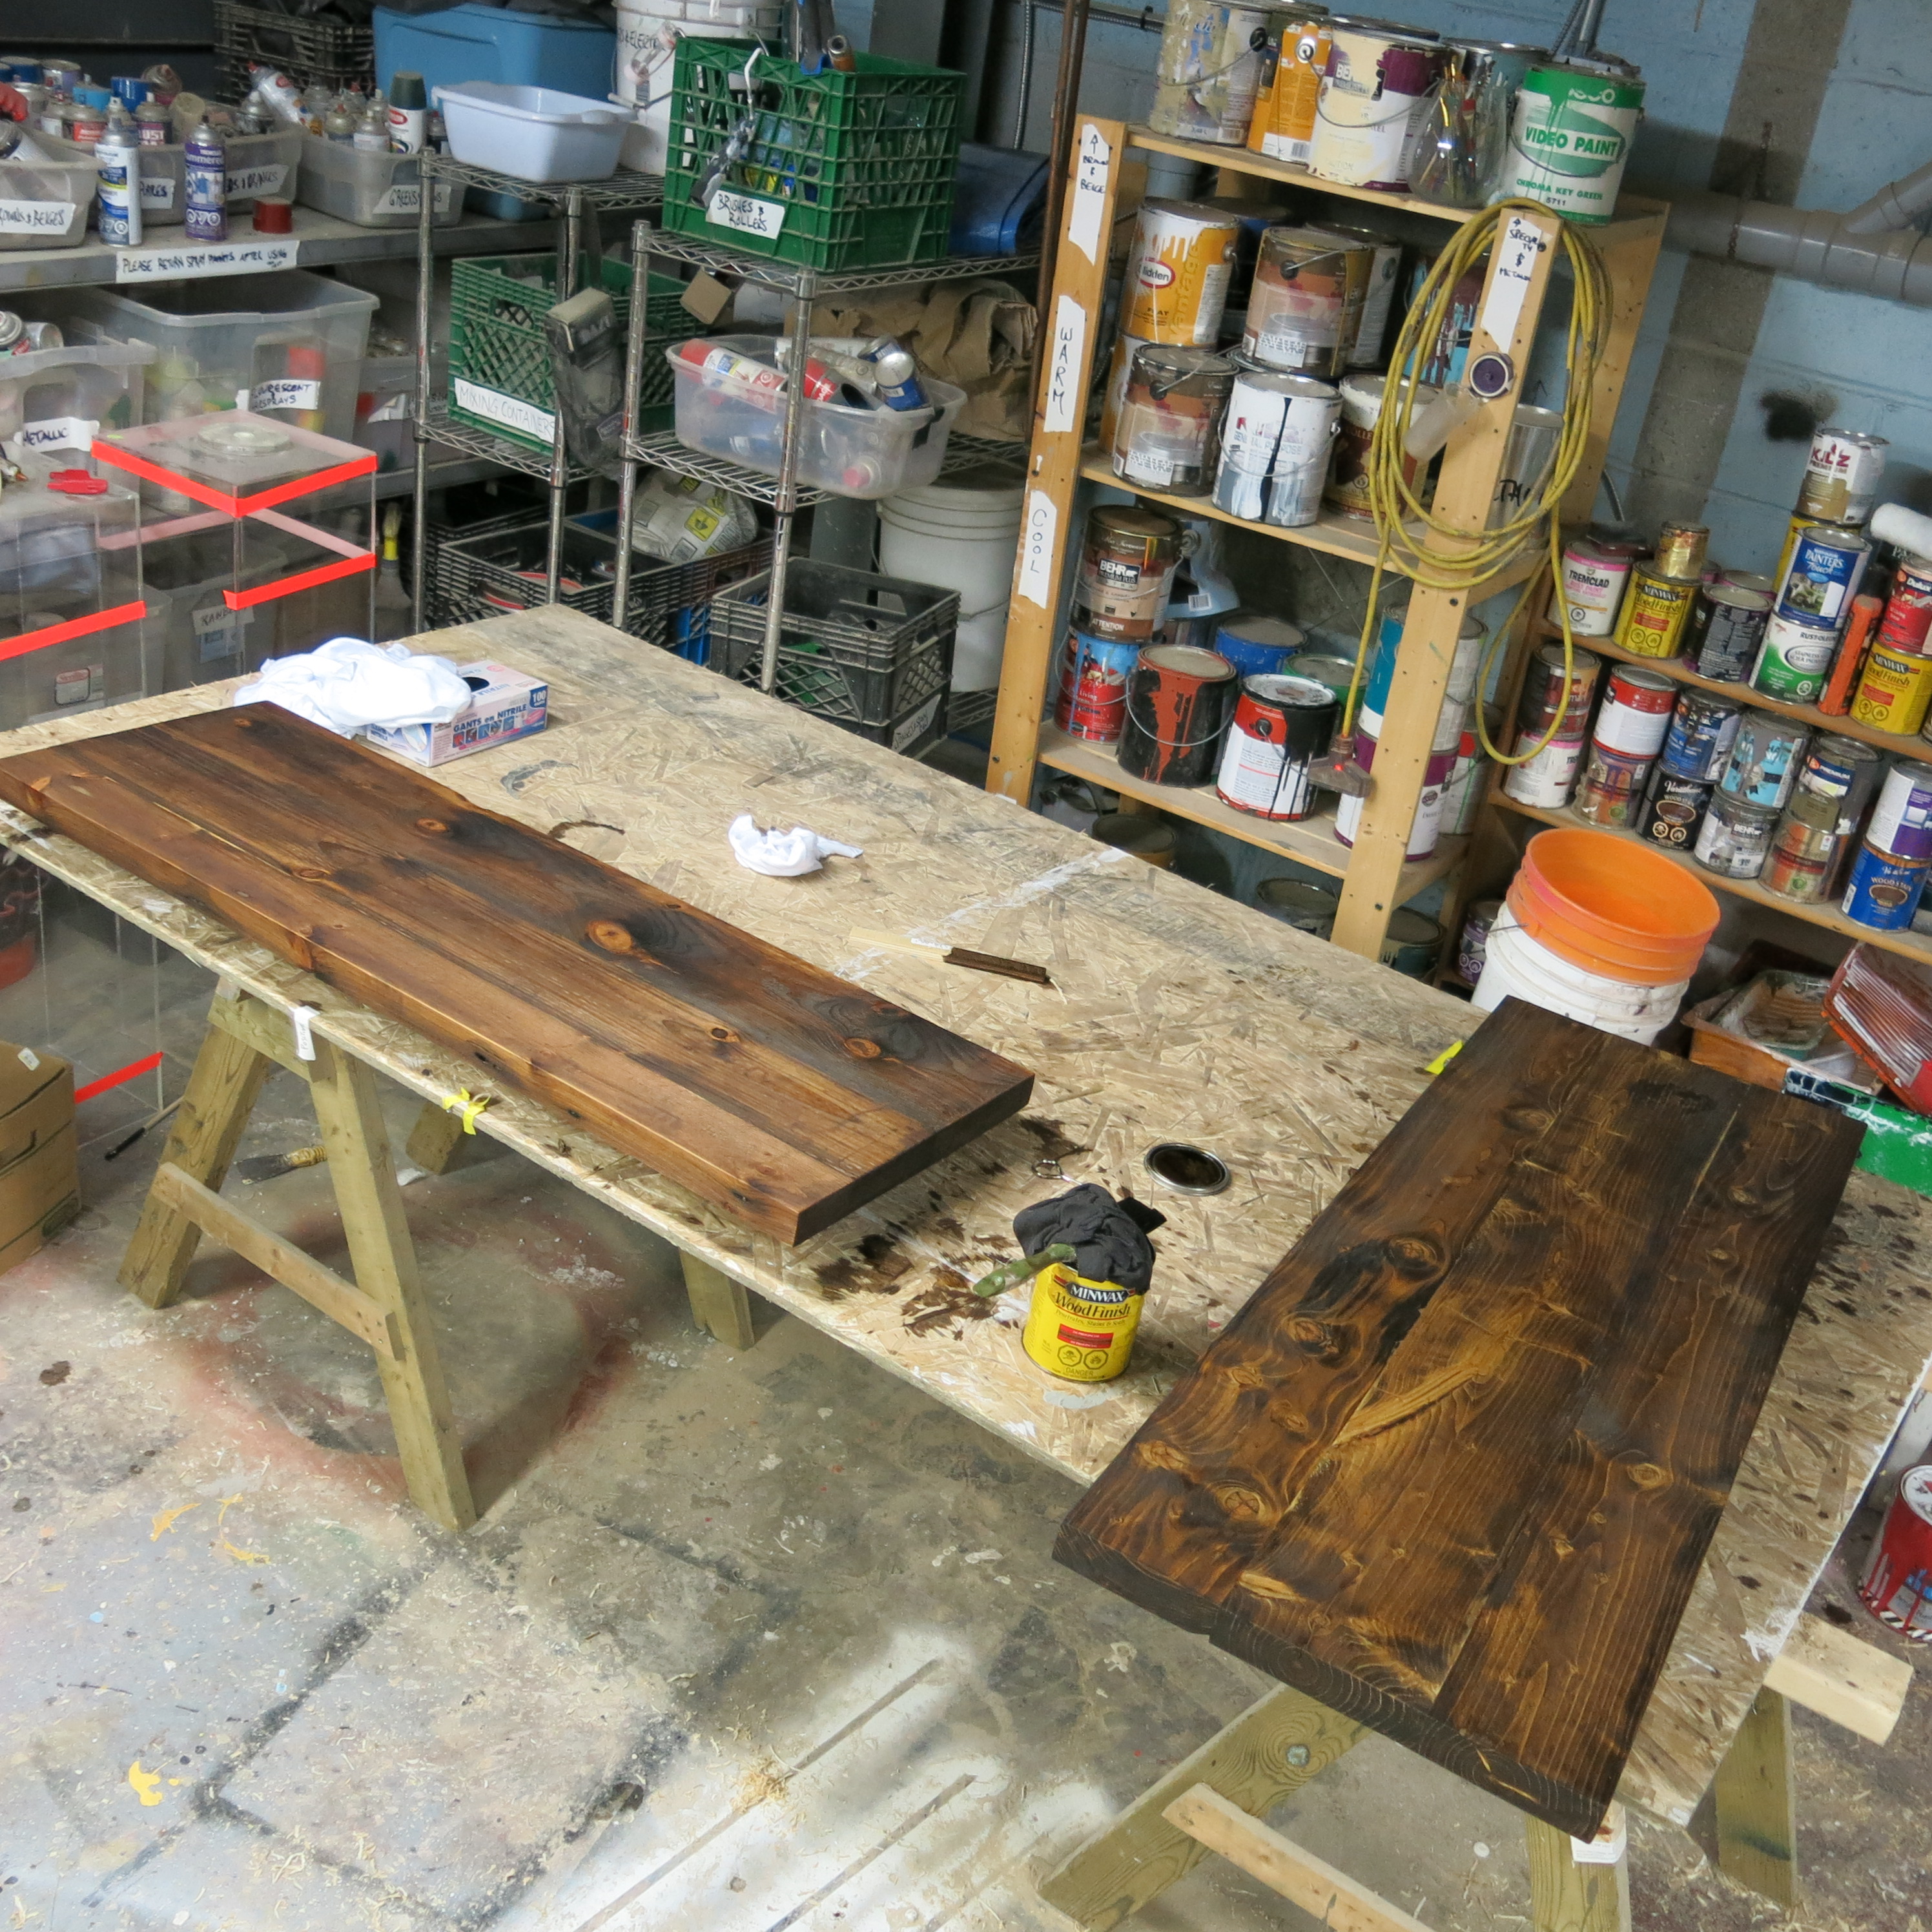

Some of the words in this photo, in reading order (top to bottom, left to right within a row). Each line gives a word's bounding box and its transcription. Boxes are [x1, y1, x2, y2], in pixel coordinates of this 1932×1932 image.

[1525, 127, 1568, 149] VIDEO
[1574, 136, 1619, 157] PAINT
[1516, 178, 1552, 193] CHROMA
[1556, 185, 1574, 196] KEY
[1577, 189, 1603, 200] GREEN
[717, 194, 754, 213] BRUSHES
[123, 258, 152, 274] PLEASE
[1147, 307, 1169, 316] FAT
[1053, 327, 1073, 416] WARM
[459, 385, 498, 417] MIXING
[501, 401, 555, 440] CONTAINERS
[1030, 509, 1047, 574] COOL
[1100, 560, 1127, 576] BEHR
[1569, 570, 1609, 588] TREMCLAD
[1091, 619, 1125, 631] ATTENTION
[1875, 653, 1907, 673] MINWAX
[532, 690, 546, 703] 100
[453, 717, 482, 733] GANTS
[497, 703, 527, 719] NITRILE
[1733, 823, 1755, 834] BEHR
[1070, 1284, 1125, 1302] MINWAX
[1054, 1291, 1091, 1315] Wood
[1092, 1303, 1131, 1319] Finish
[1065, 1367, 1094, 1377] DANGER
